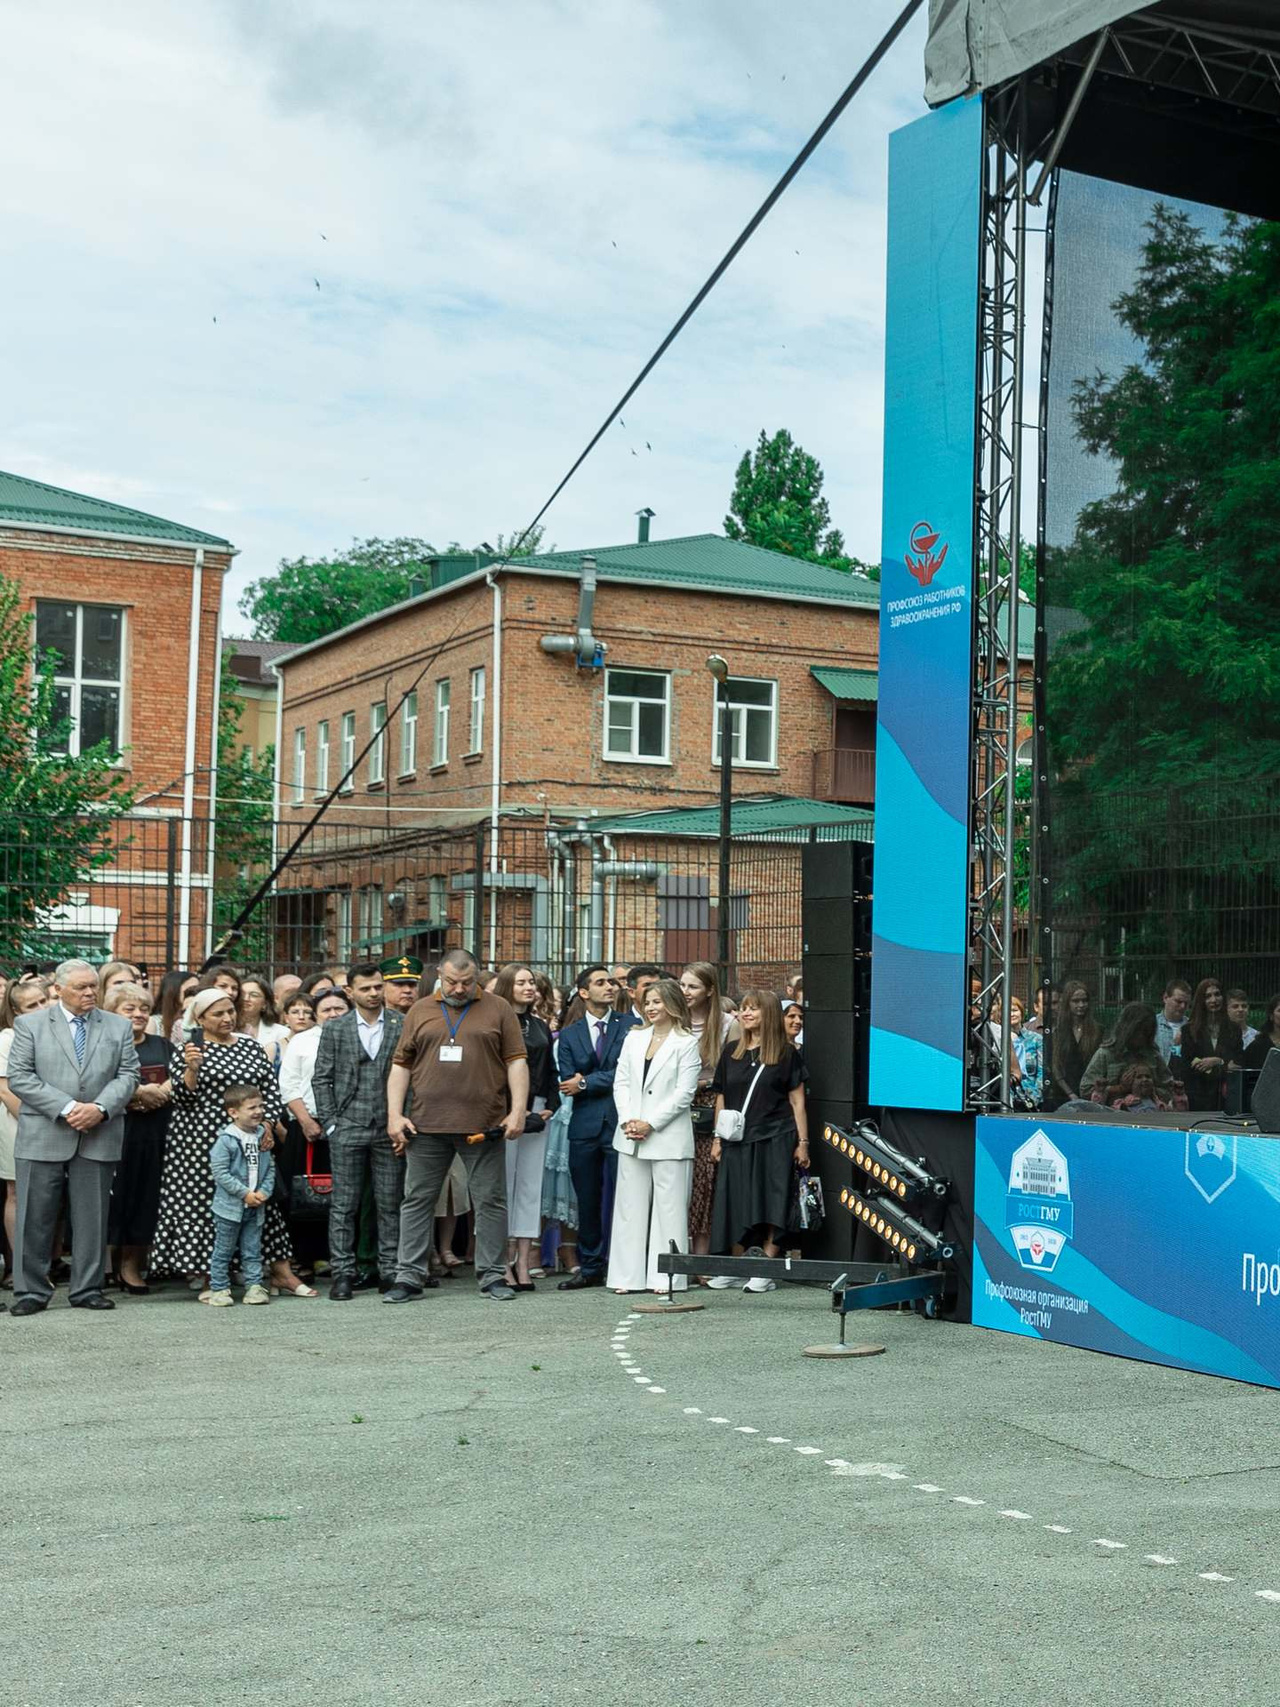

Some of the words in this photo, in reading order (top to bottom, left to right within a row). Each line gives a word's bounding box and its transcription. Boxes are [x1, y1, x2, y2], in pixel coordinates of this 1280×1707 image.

[887, 594, 923, 613] ПРОФСОЮЗ
[924, 585, 966, 605] РАБОТНИКОВ
[951, 602, 962, 614] РФ
[1018, 1203, 1061, 1221] РОСТГМУ
[985, 1279, 1037, 1303] Профсоюзная
[1037, 1291, 1089, 1315] организация
[1020, 1307, 1053, 1329] РостГМУ
